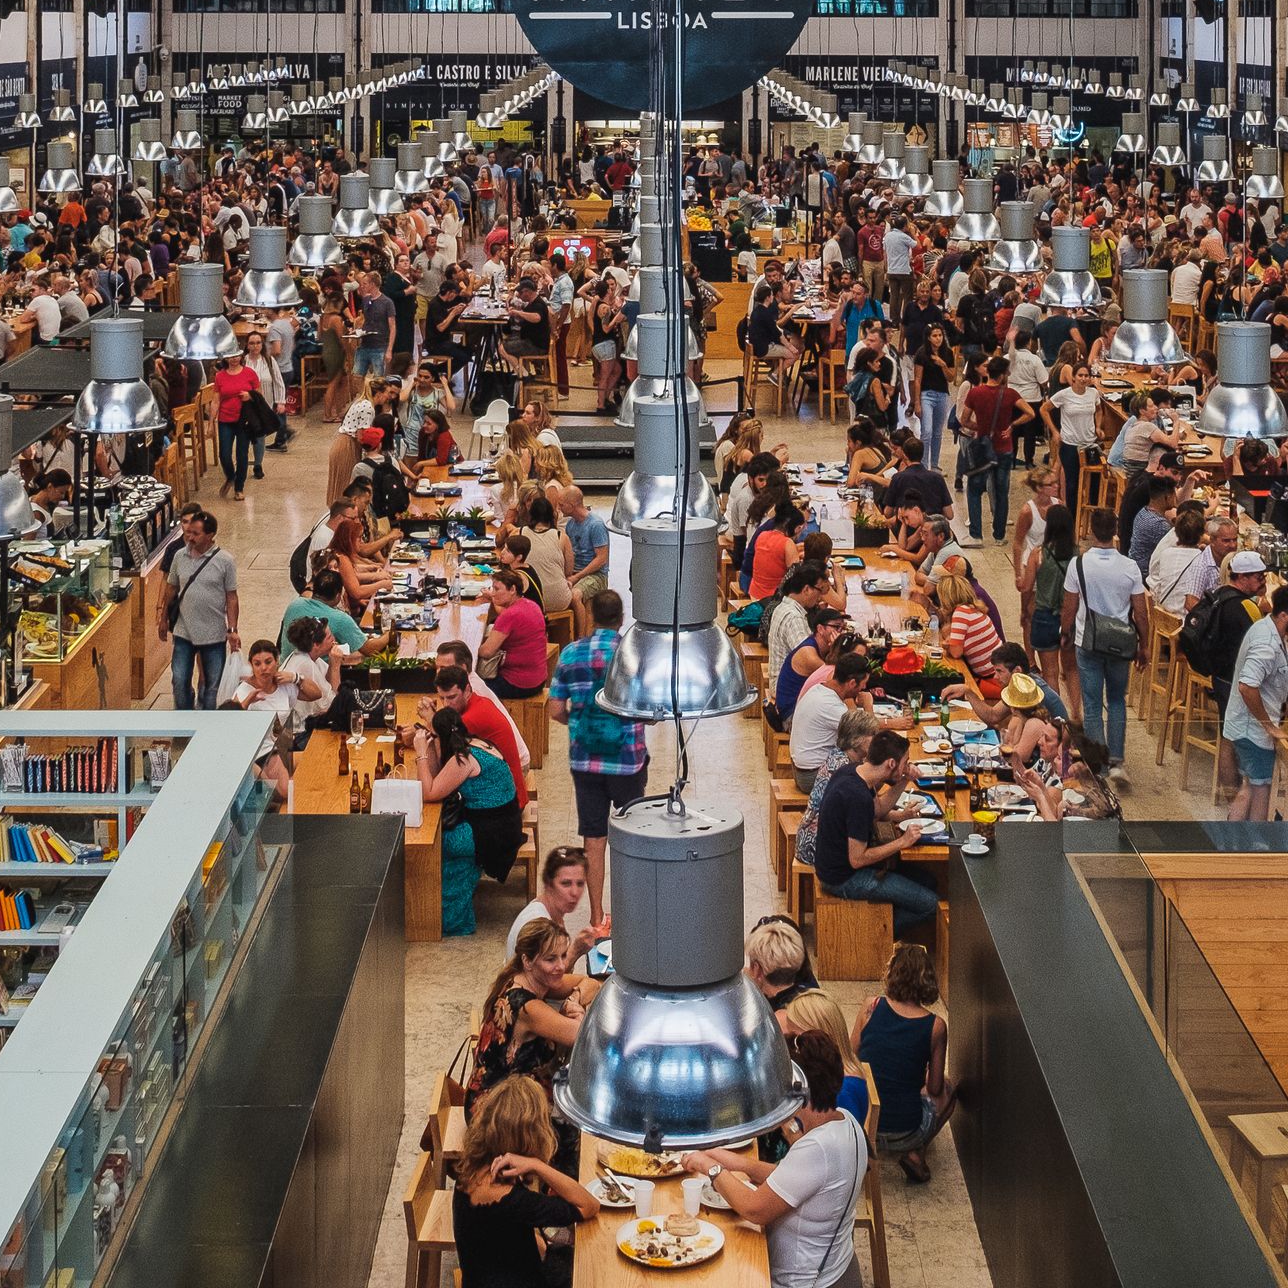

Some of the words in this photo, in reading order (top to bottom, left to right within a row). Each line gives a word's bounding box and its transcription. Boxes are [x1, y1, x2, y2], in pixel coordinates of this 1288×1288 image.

[436, 65, 480, 80] CASTRO
[485, 65, 491, 79] E
[495, 64, 528, 80] SILVA
[805, 66, 859, 82] MARLENE
[863, 66, 890, 82] VIEI
